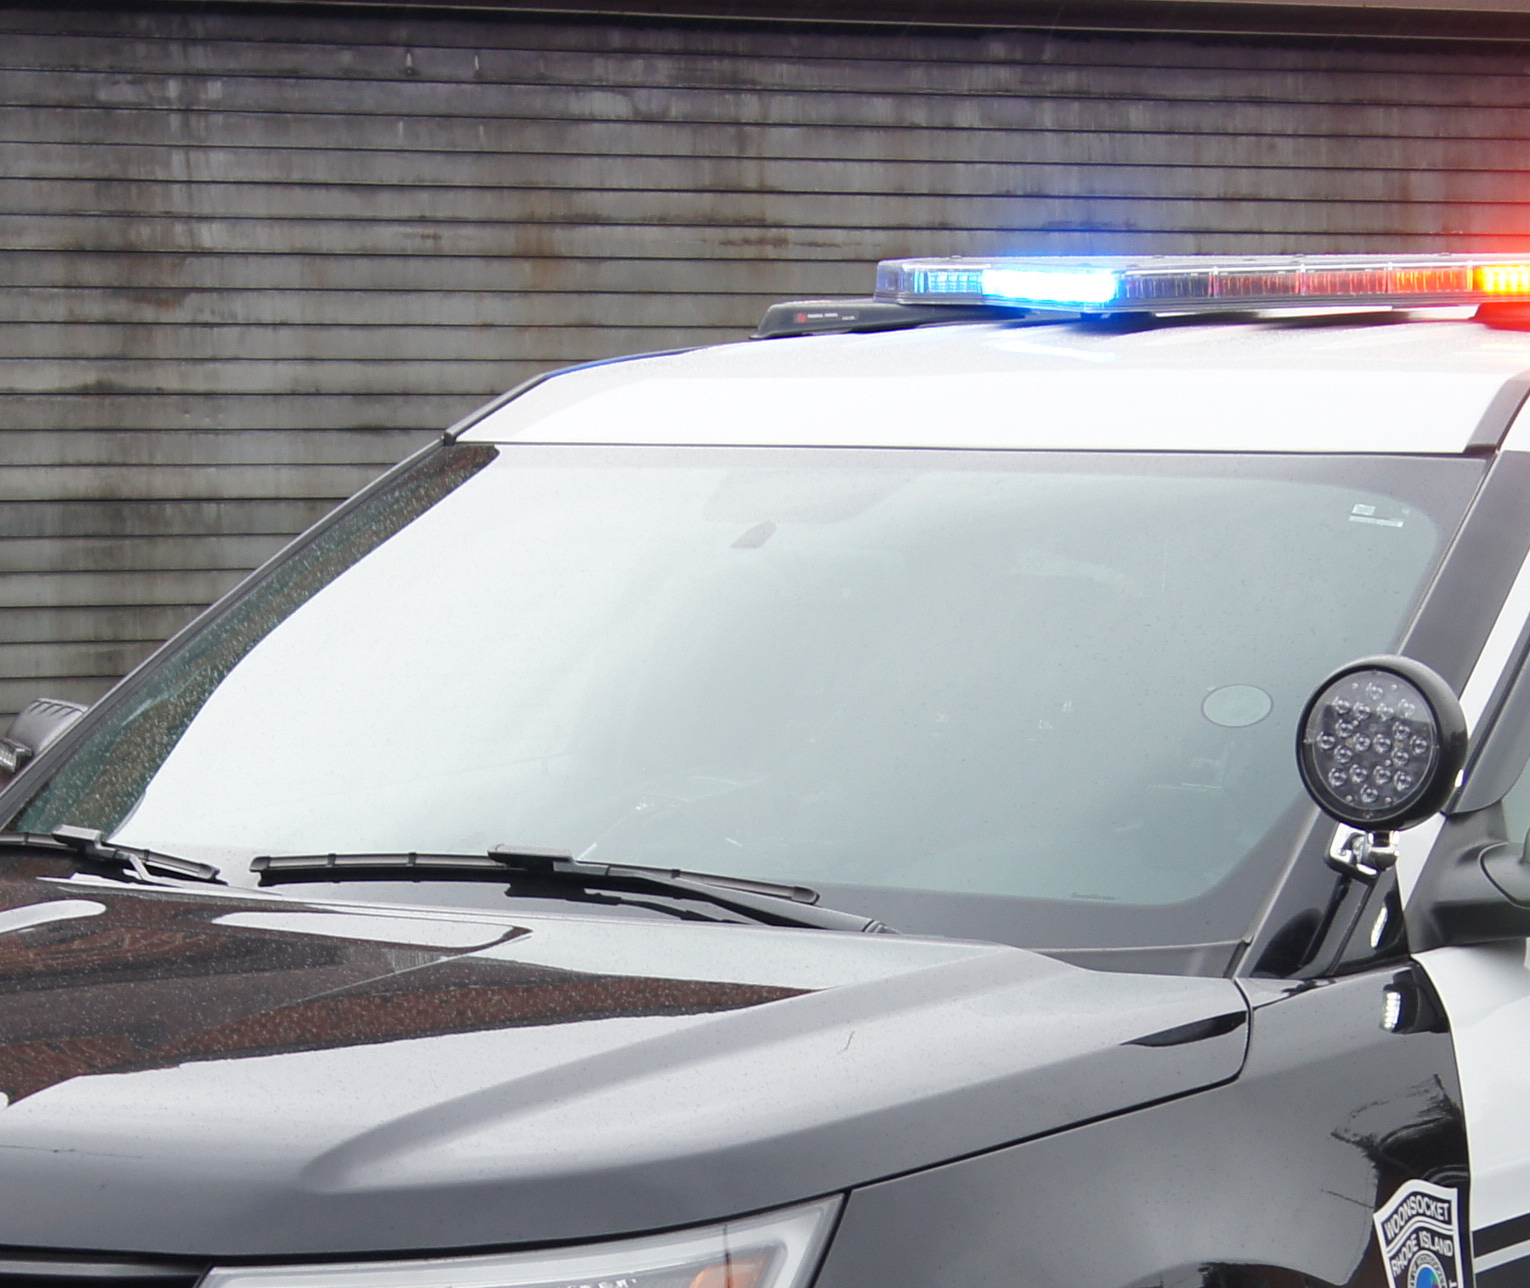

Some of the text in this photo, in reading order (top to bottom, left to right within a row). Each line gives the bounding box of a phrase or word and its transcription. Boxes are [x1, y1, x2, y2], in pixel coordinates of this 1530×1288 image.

[1385, 1195, 1451, 1241] WOONSOCKET
[1391, 1231, 1454, 1277] RHODE ISLAND
